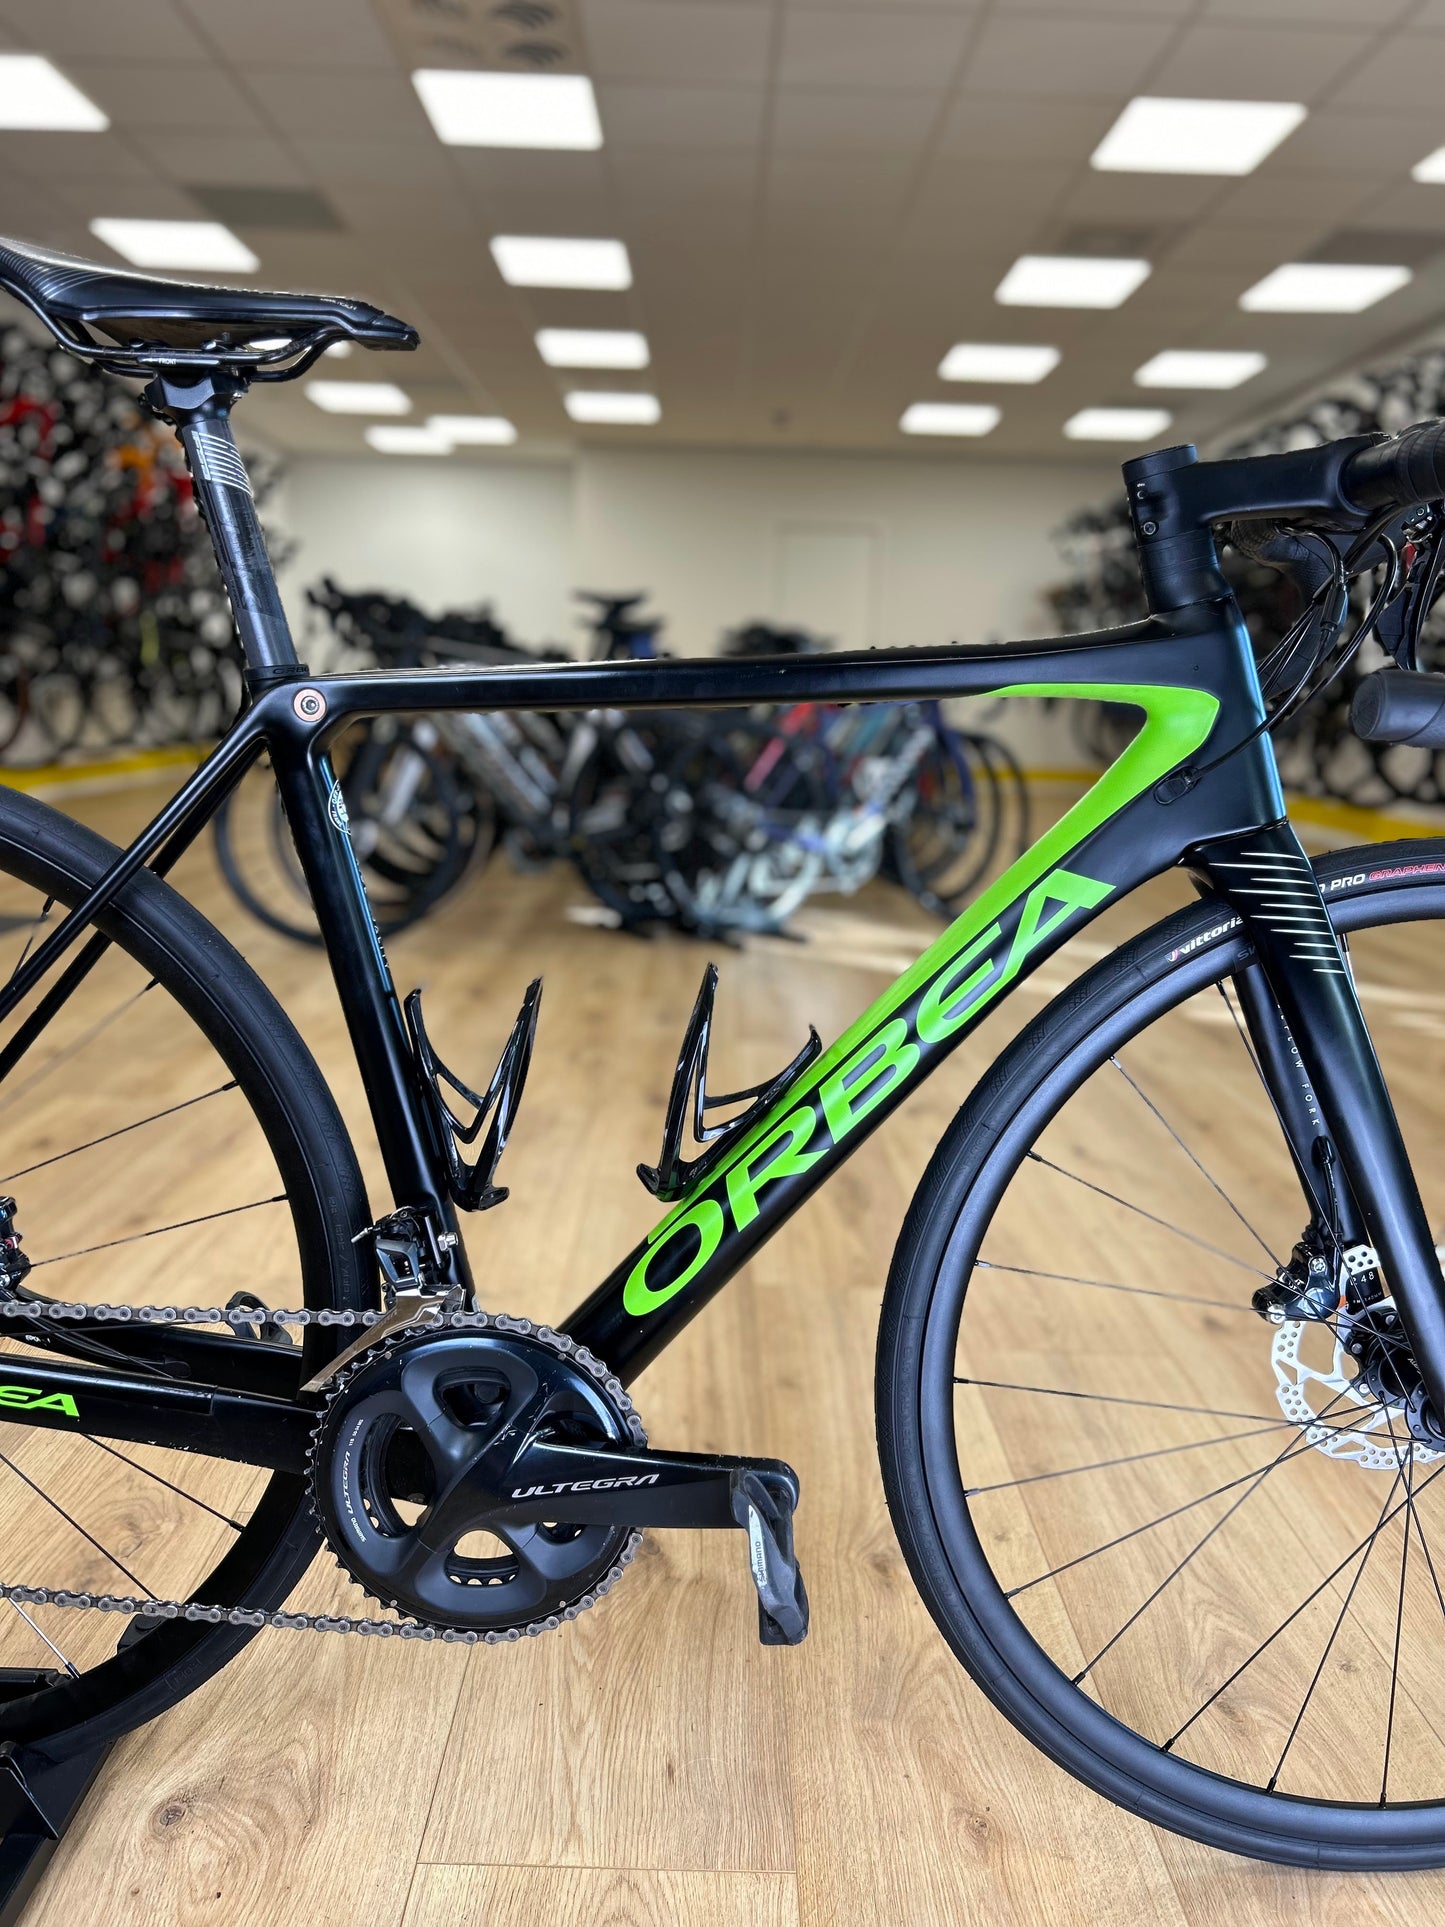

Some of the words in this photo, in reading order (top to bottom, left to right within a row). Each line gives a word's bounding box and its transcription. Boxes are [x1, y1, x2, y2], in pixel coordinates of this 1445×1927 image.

[1330, 873, 1366, 891] PRO
[623, 868, 1116, 1316] ORBEA
[1301, 1083, 1320, 1126] FORK
[342, 1451, 354, 1515] ULTEGRA
[511, 1473, 661, 1499] ULTEGRA
